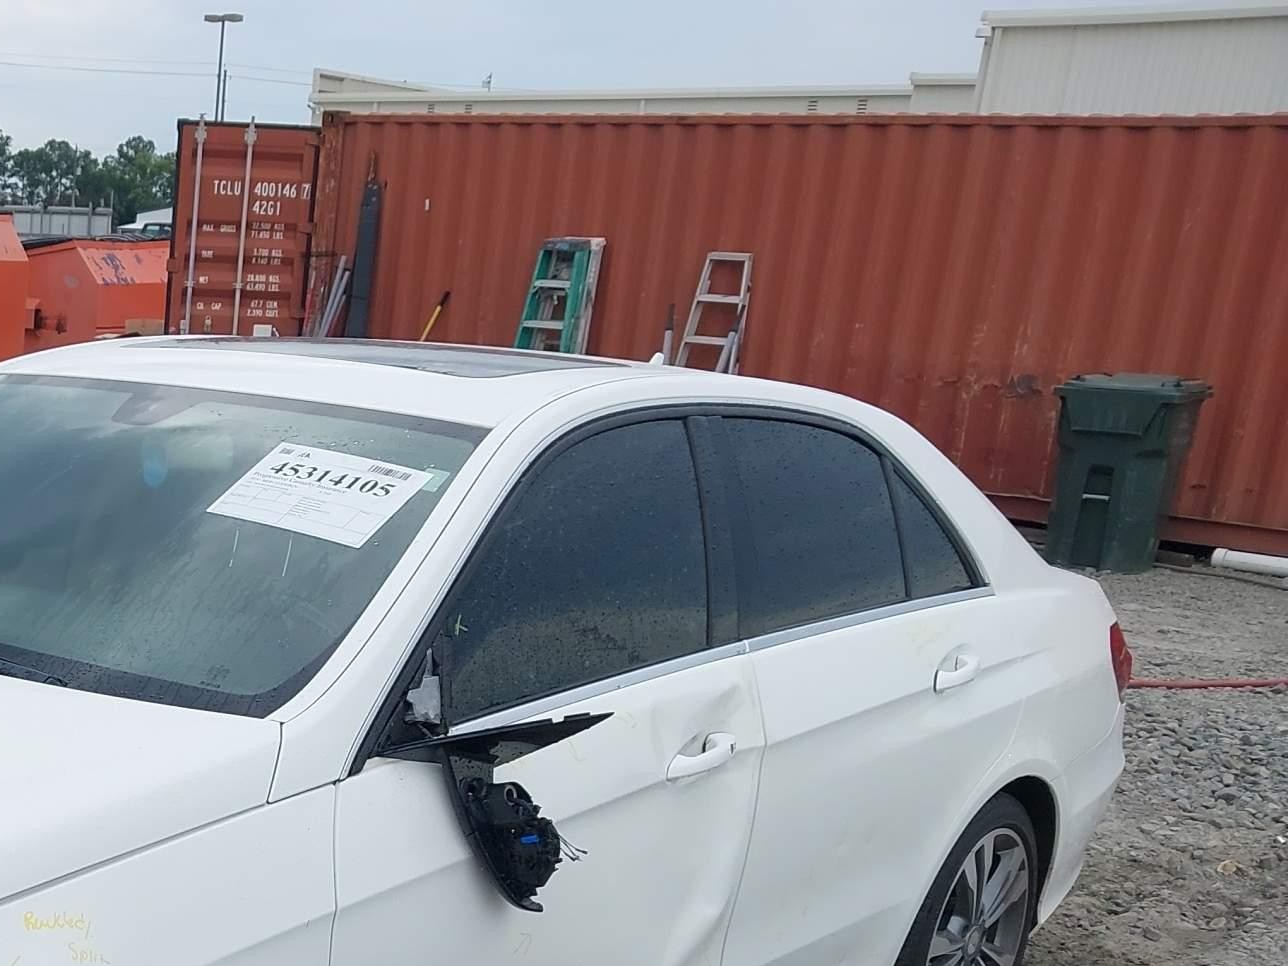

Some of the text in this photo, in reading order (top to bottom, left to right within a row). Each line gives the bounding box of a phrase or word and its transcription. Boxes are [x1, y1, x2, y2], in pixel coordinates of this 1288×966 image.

[214, 180, 311, 199] TCLU 400146 7
[253, 200, 281, 216] 42G1
[270, 461, 397, 498] 45314105
